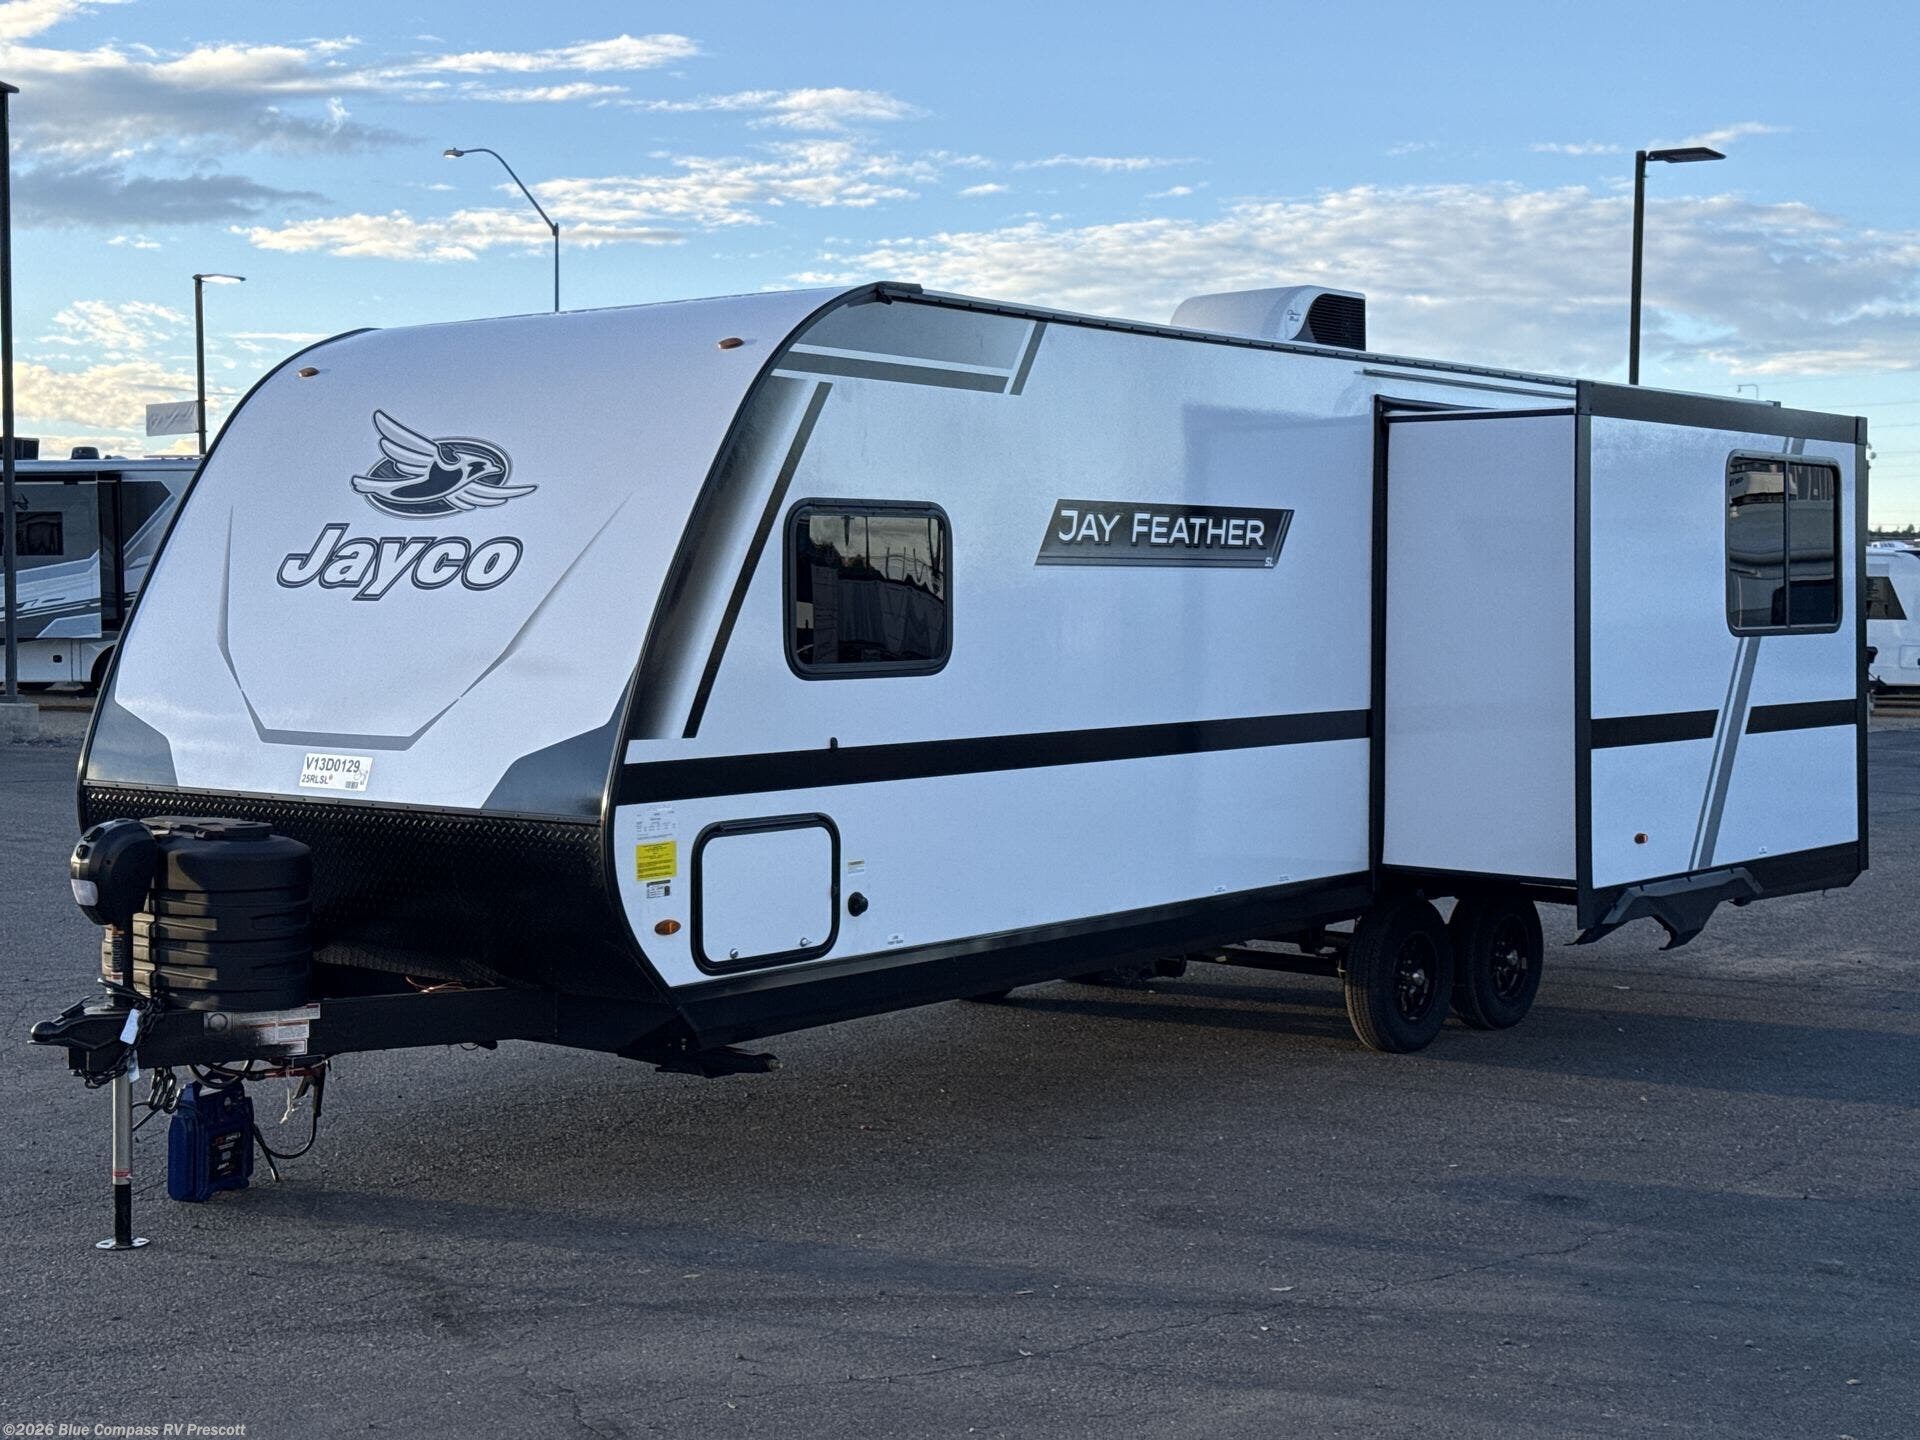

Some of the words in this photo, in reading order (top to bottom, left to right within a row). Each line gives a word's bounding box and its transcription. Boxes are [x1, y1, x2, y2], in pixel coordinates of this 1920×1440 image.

[1058, 510, 1121, 543] JAY
[1132, 512, 1266, 547] FEATHER
[277, 523, 523, 601] Jayco
[306, 756, 361, 774] V13D0129
